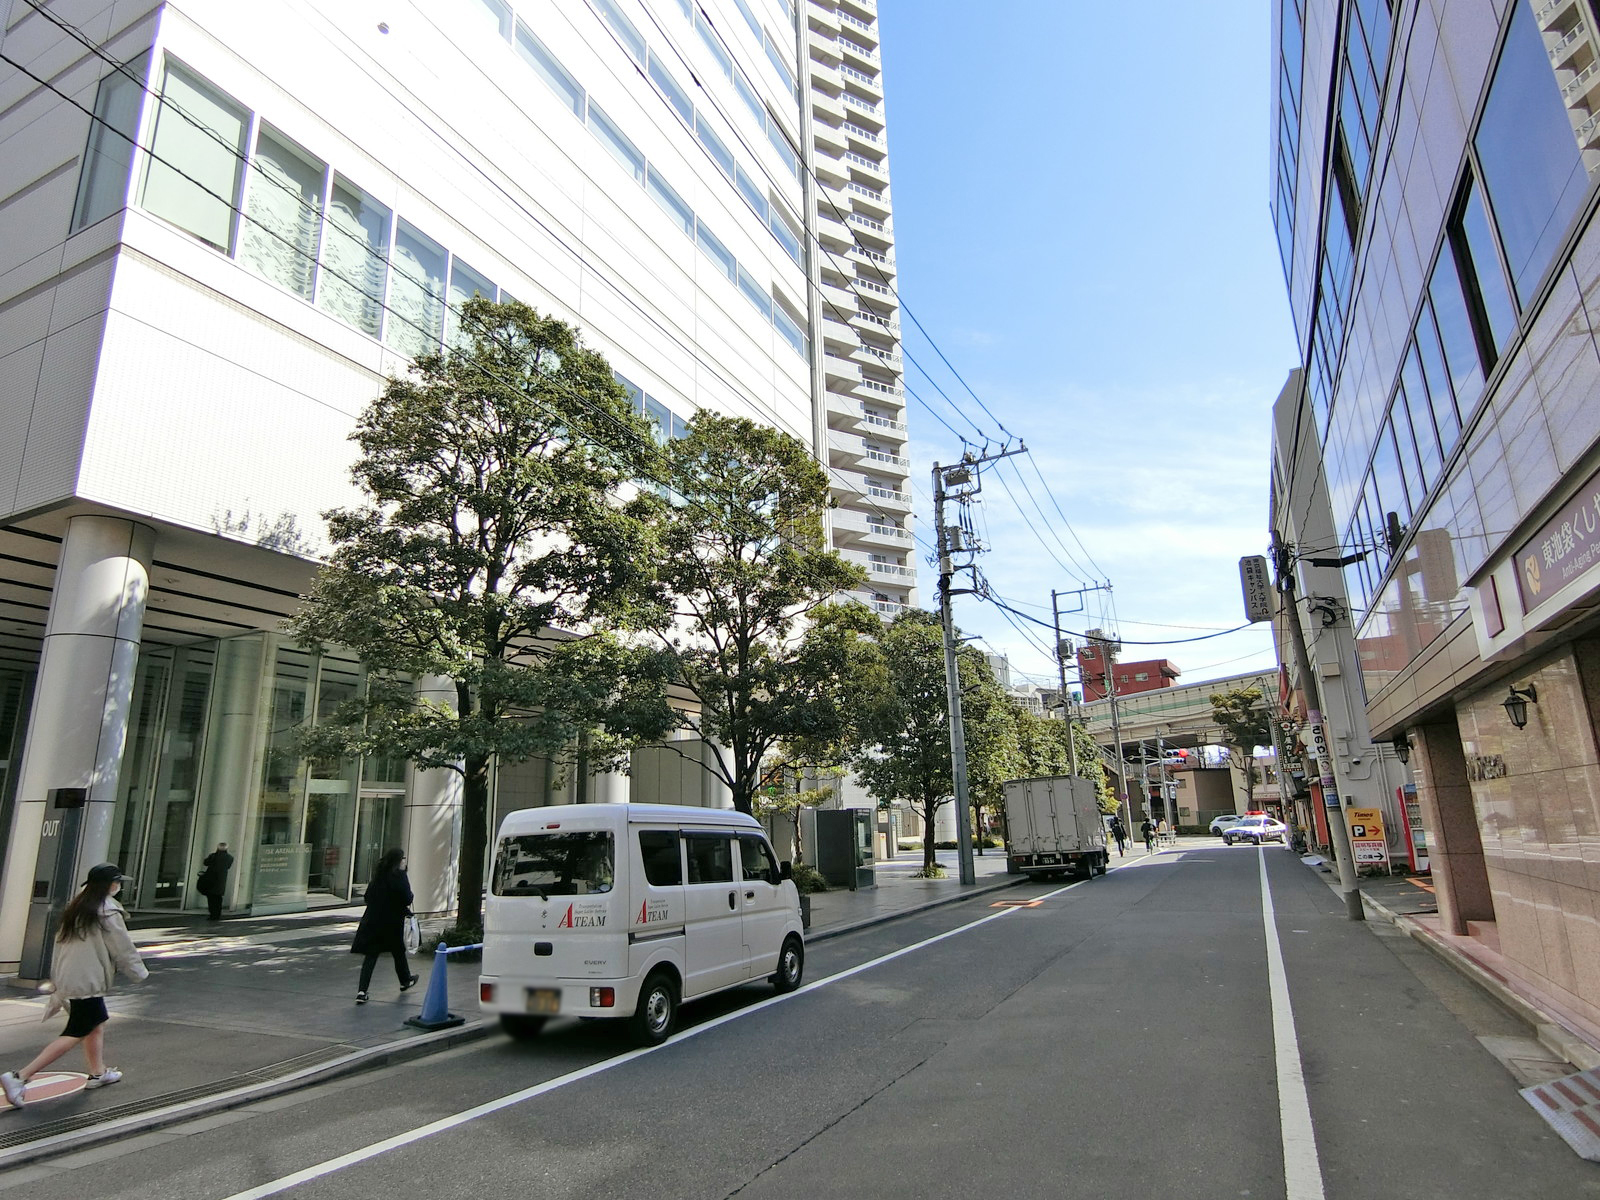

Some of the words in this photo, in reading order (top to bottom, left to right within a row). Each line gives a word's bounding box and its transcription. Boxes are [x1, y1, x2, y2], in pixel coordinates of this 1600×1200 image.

[42, 820, 60, 837] OUT
[1353, 826, 1364, 837] P
[574, 915, 606, 927] TEAM
[647, 909, 669, 922] TEAM
